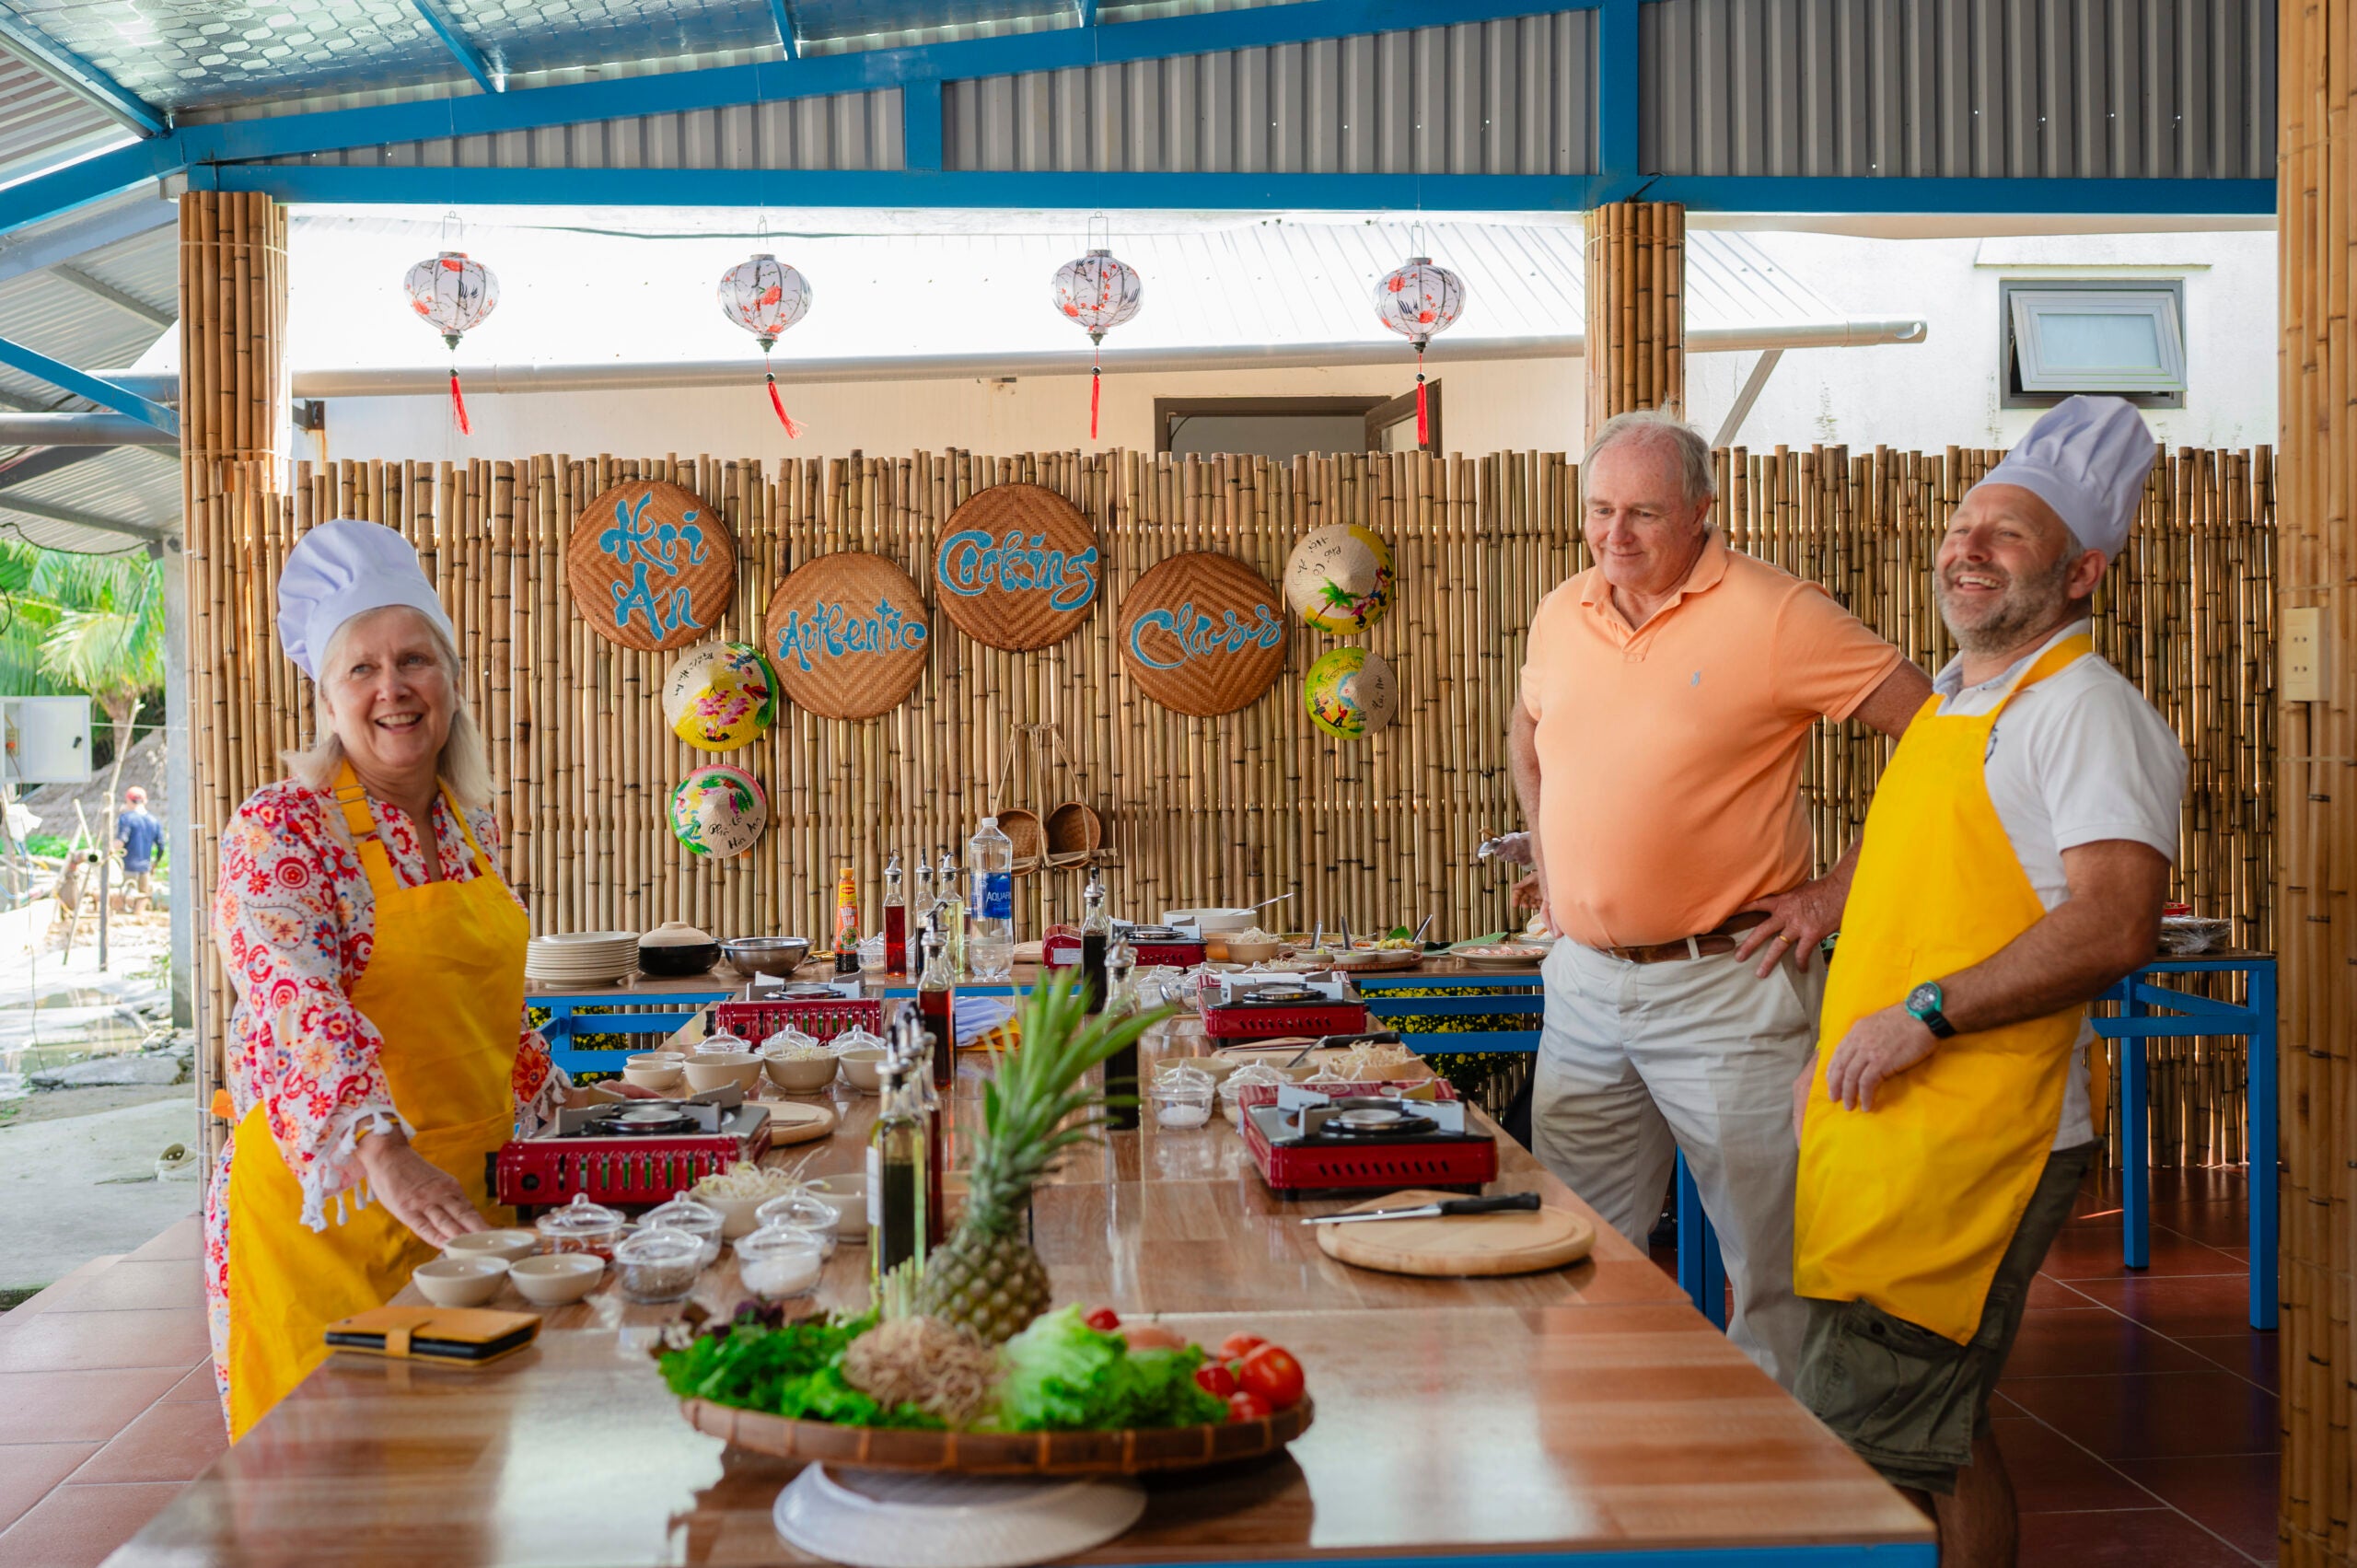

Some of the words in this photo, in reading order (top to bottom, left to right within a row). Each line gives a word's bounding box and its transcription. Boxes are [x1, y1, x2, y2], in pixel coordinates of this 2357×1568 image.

[611, 561, 706, 642] An
[938, 529, 1097, 611] Cooking
[777, 597, 927, 671] Authentic
